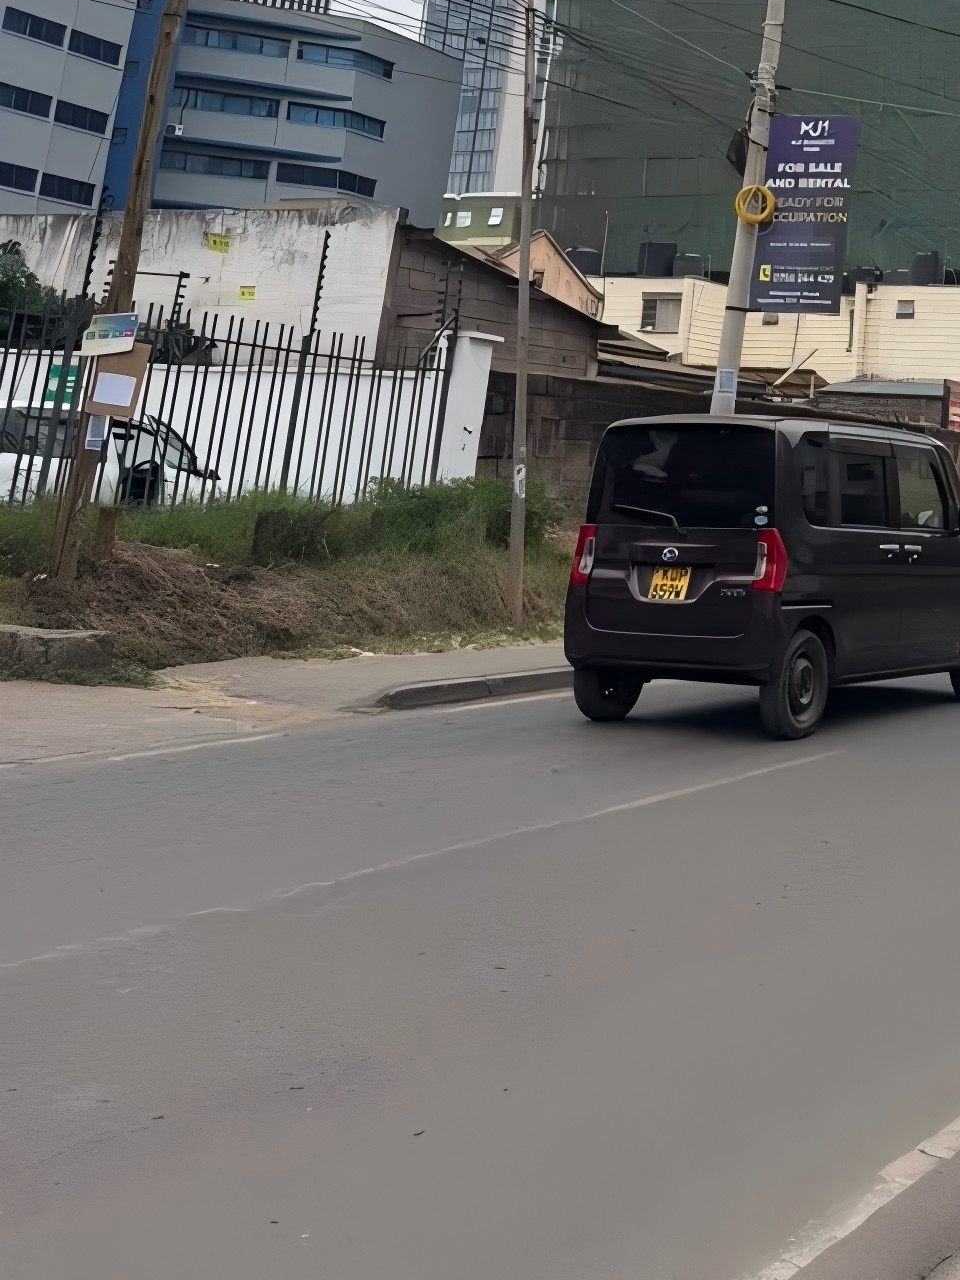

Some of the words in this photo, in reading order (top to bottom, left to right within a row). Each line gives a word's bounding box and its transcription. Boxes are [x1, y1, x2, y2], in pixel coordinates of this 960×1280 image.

[777, 162, 805, 173] FOR
[808, 162, 843, 173] SALE
[765, 178, 796, 188] AND
[798, 177, 851, 188] RENTAL
[776, 197, 812, 208] EADY
[815, 196, 844, 207] FOR
[772, 211, 848, 223] CCUPATION
